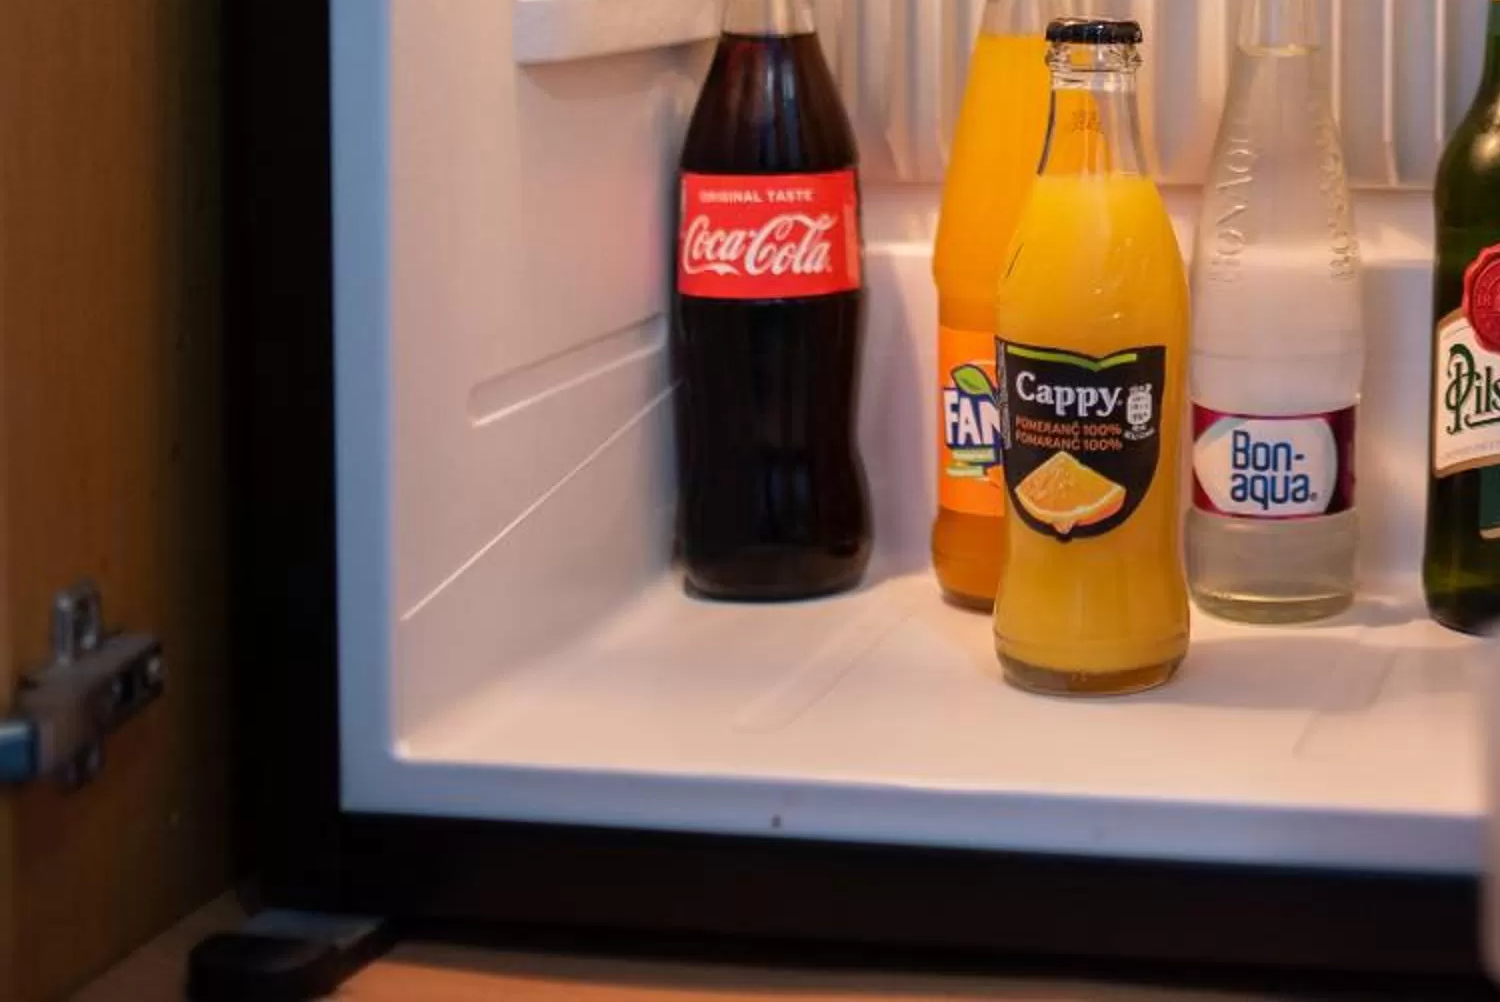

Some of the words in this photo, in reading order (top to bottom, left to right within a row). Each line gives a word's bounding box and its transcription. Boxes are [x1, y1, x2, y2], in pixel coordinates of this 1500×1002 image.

[699, 189, 763, 204] ORIGINAL
[767, 188, 814, 203] TASTE
[682, 214, 837, 276] Coca-Cola
[1016, 371, 1122, 416] Cappy
[943, 389, 1001, 445] FAN
[1083, 423, 1121, 436] 100%
[1083, 438, 1122, 451] 100%
[1232, 430, 1305, 471] Bon-
[1230, 473, 1310, 510] aqua
